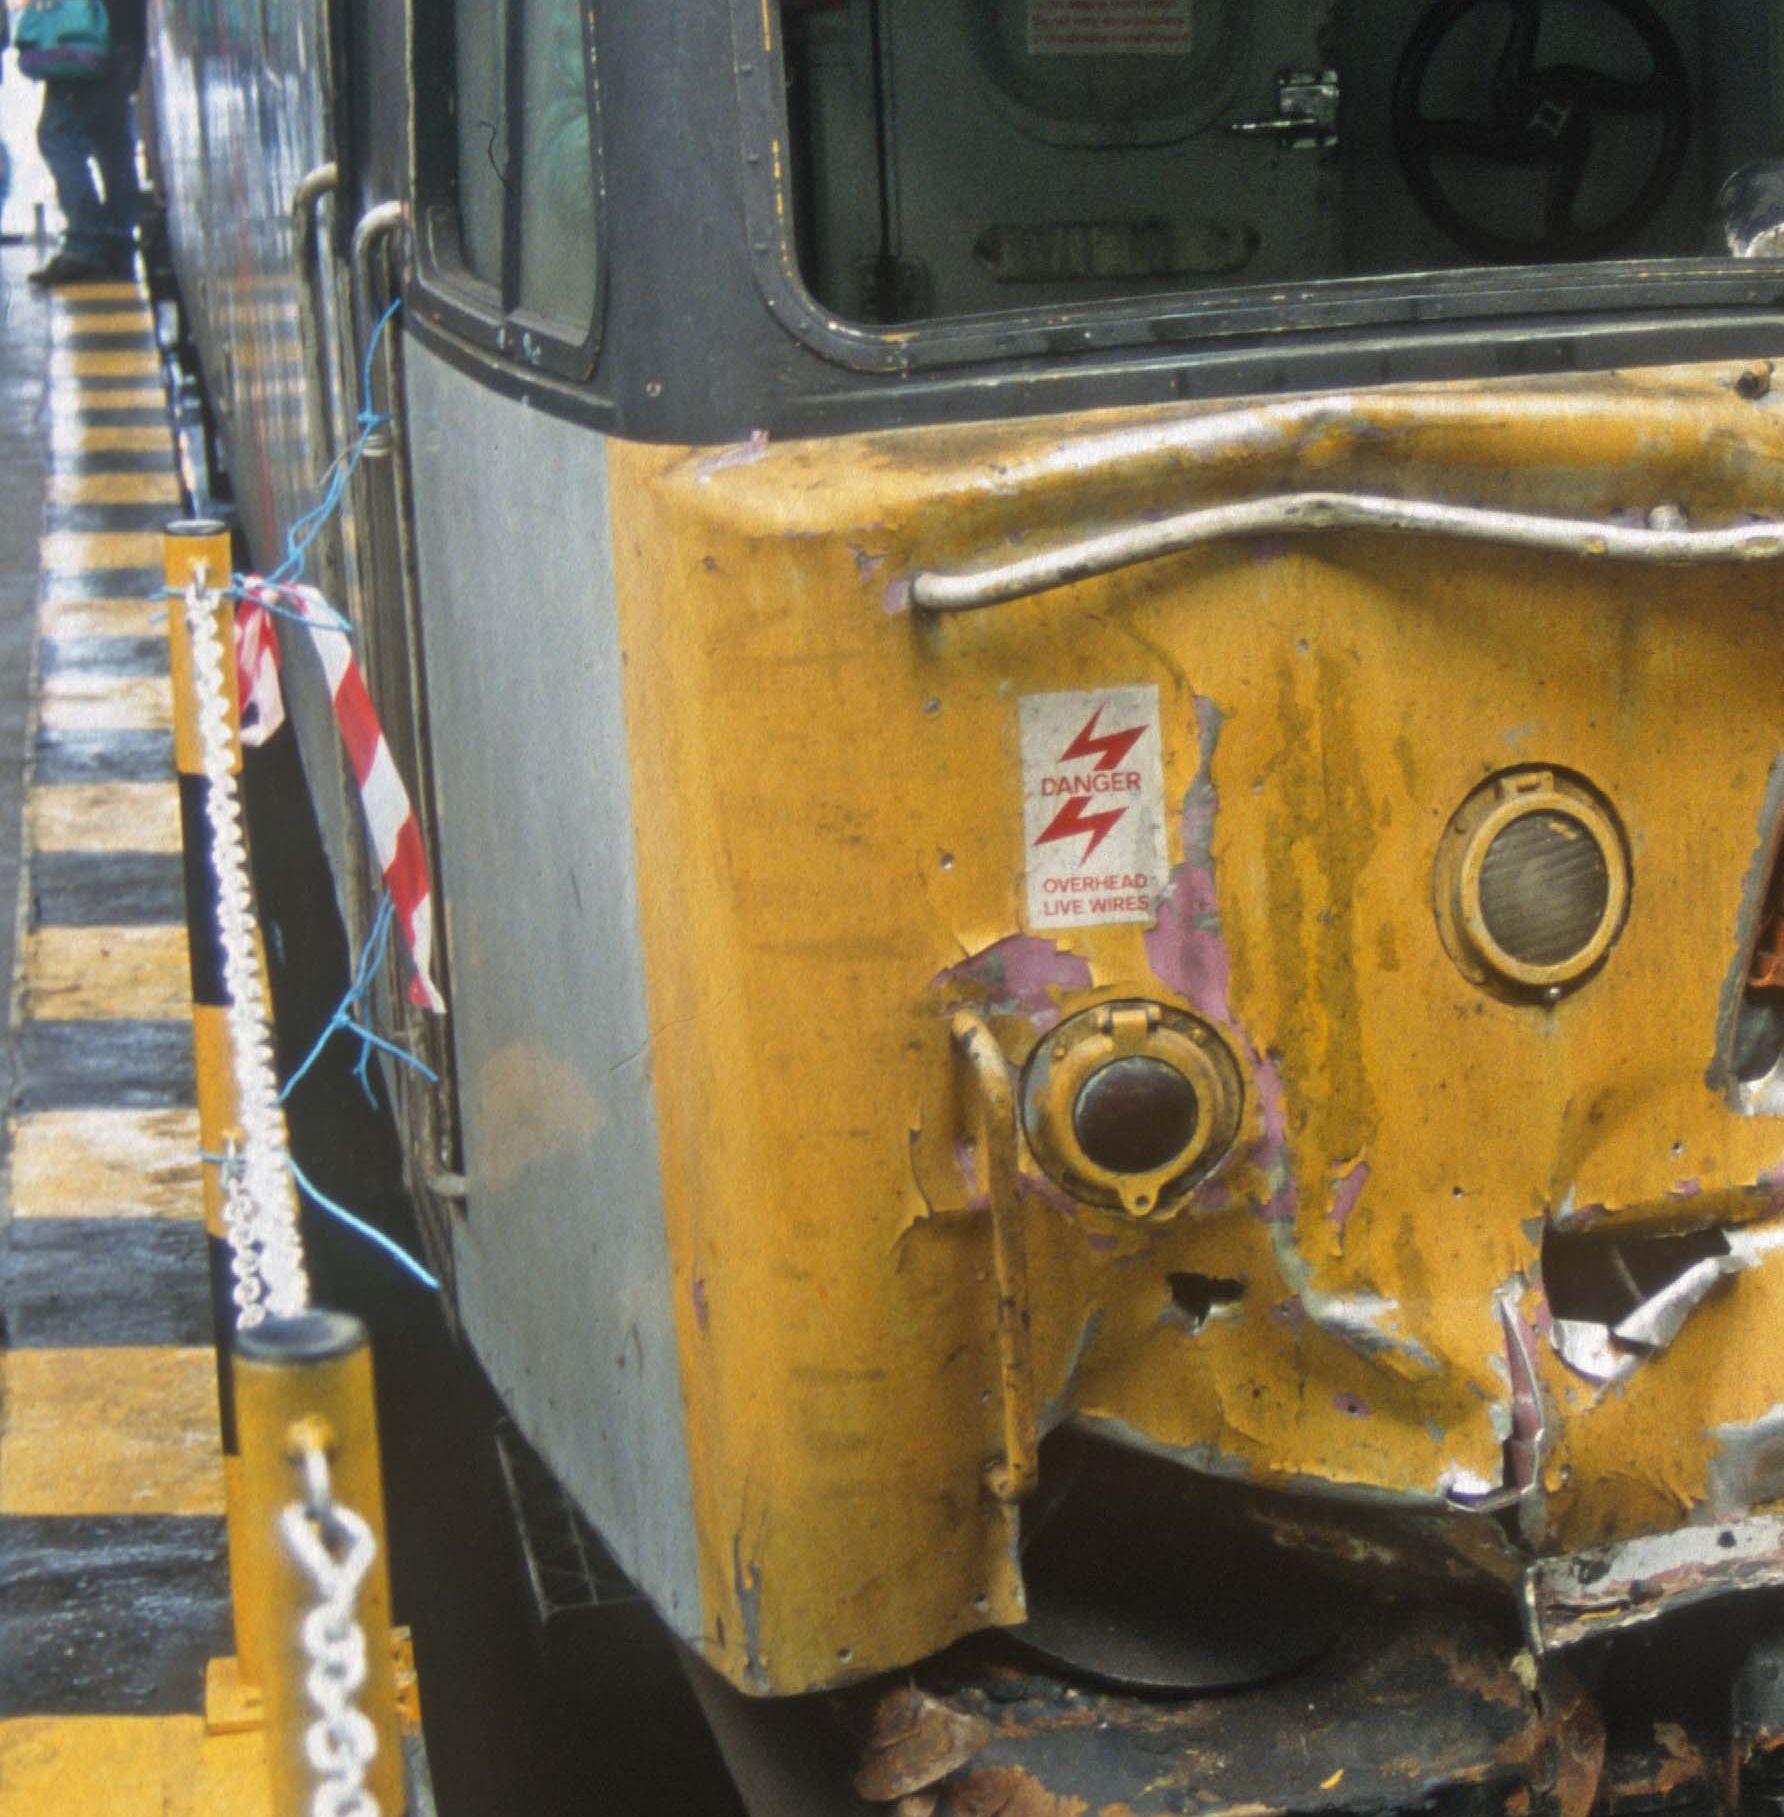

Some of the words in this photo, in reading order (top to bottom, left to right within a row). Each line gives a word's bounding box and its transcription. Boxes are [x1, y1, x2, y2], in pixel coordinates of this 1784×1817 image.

[1041, 772, 1141, 796] DANGER
[1043, 873, 1148, 893] OVERHEAD
[1043, 900, 1083, 916] LIVE
[1089, 895, 1150, 913] WIRES
